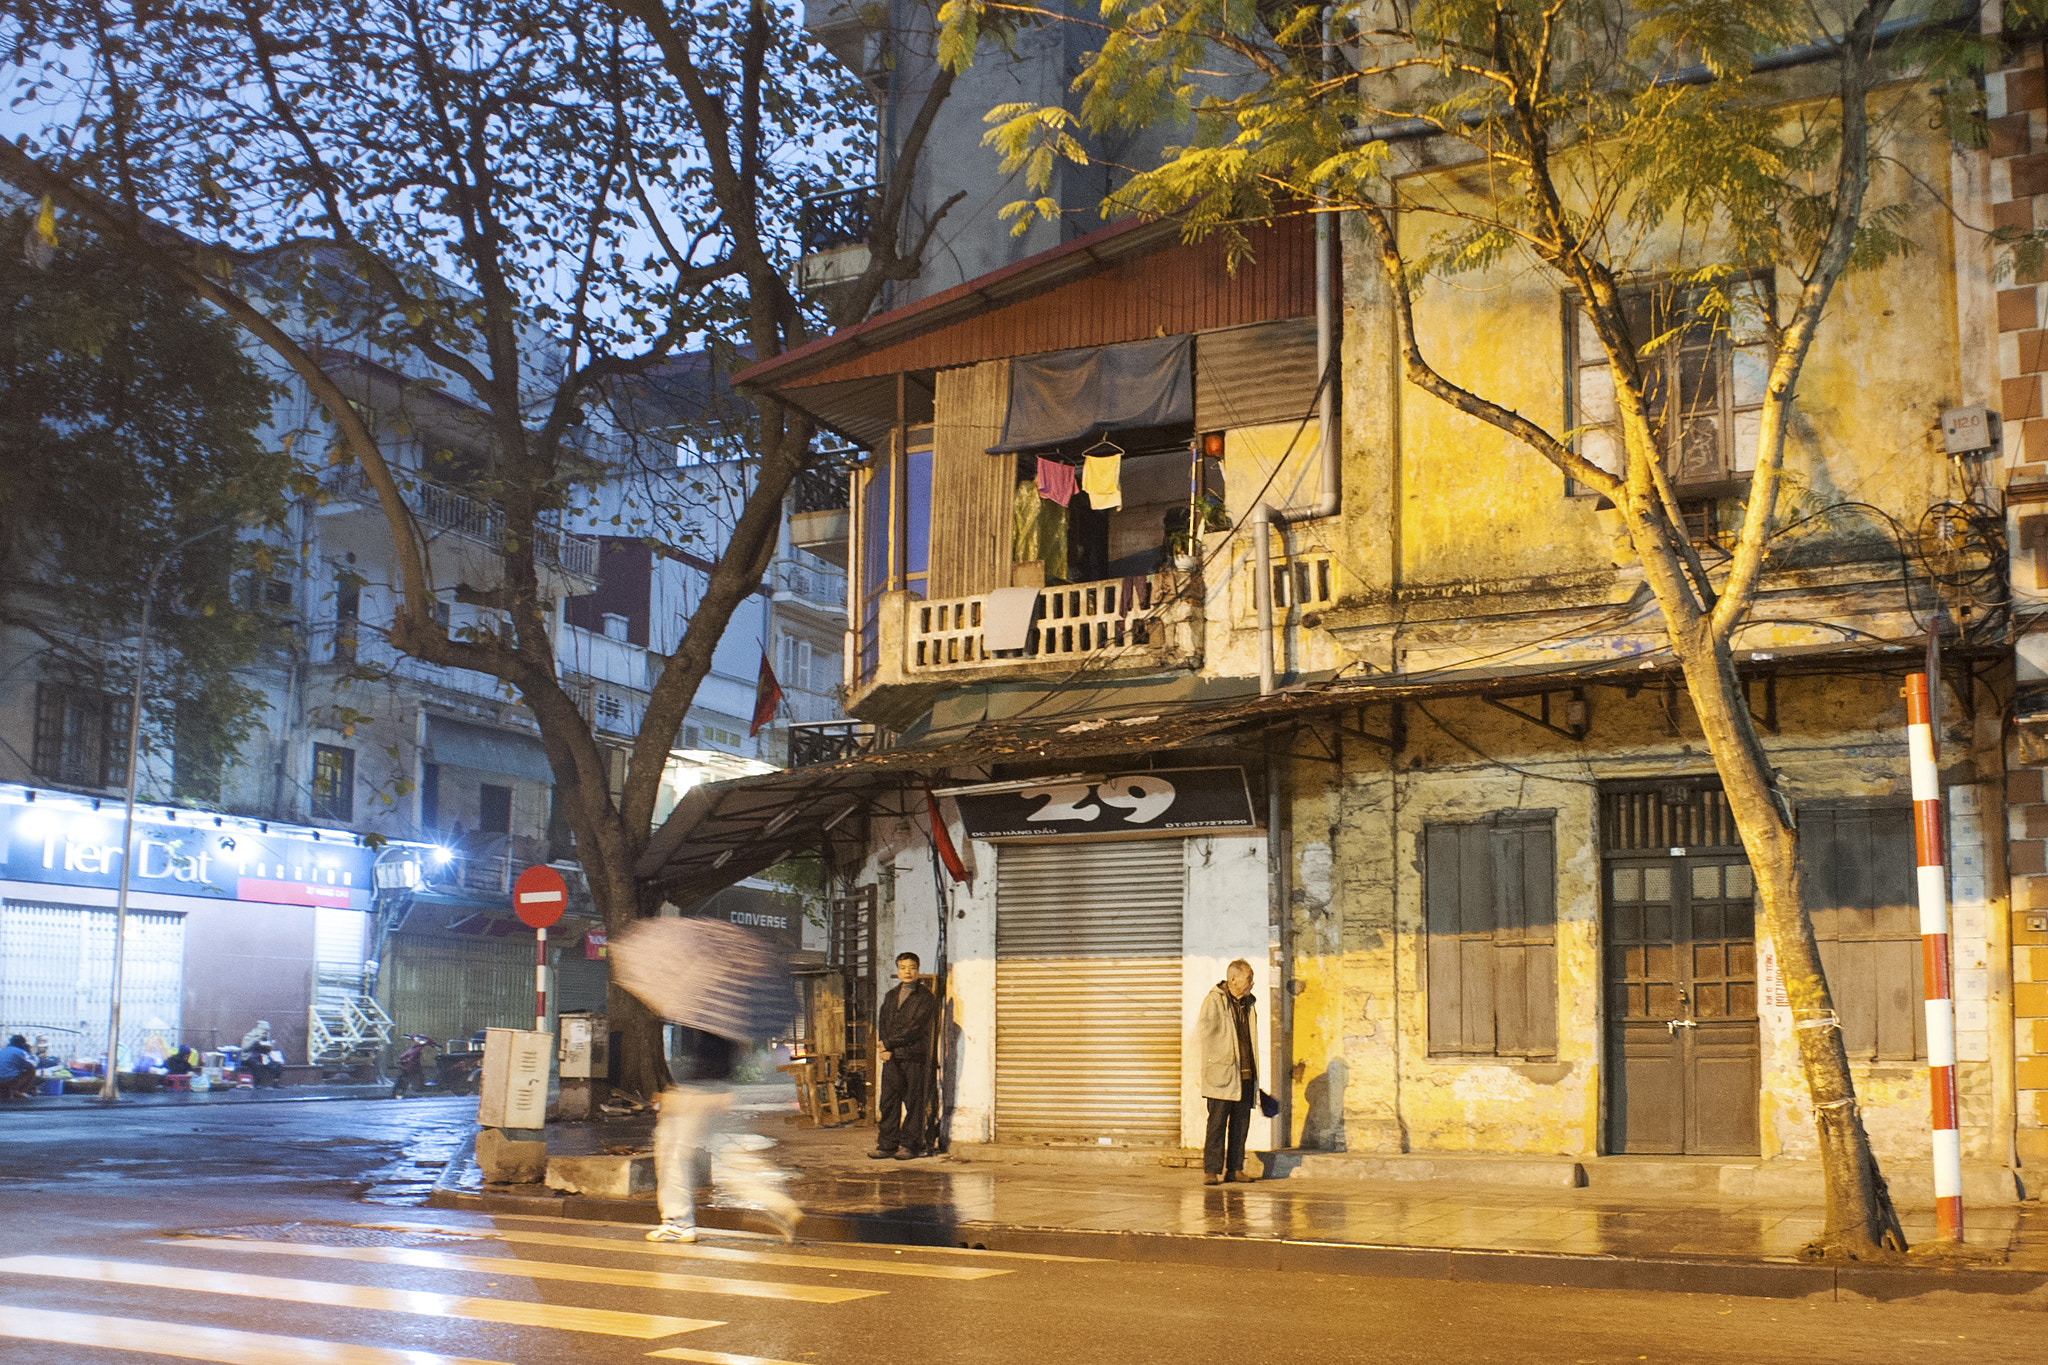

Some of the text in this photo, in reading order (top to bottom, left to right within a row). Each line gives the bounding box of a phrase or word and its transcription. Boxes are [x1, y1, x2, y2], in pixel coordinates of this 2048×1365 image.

[1020, 775, 1176, 823] 29
[139, 839, 212, 884] Dat
[731, 910, 787, 929] CONVERSE
